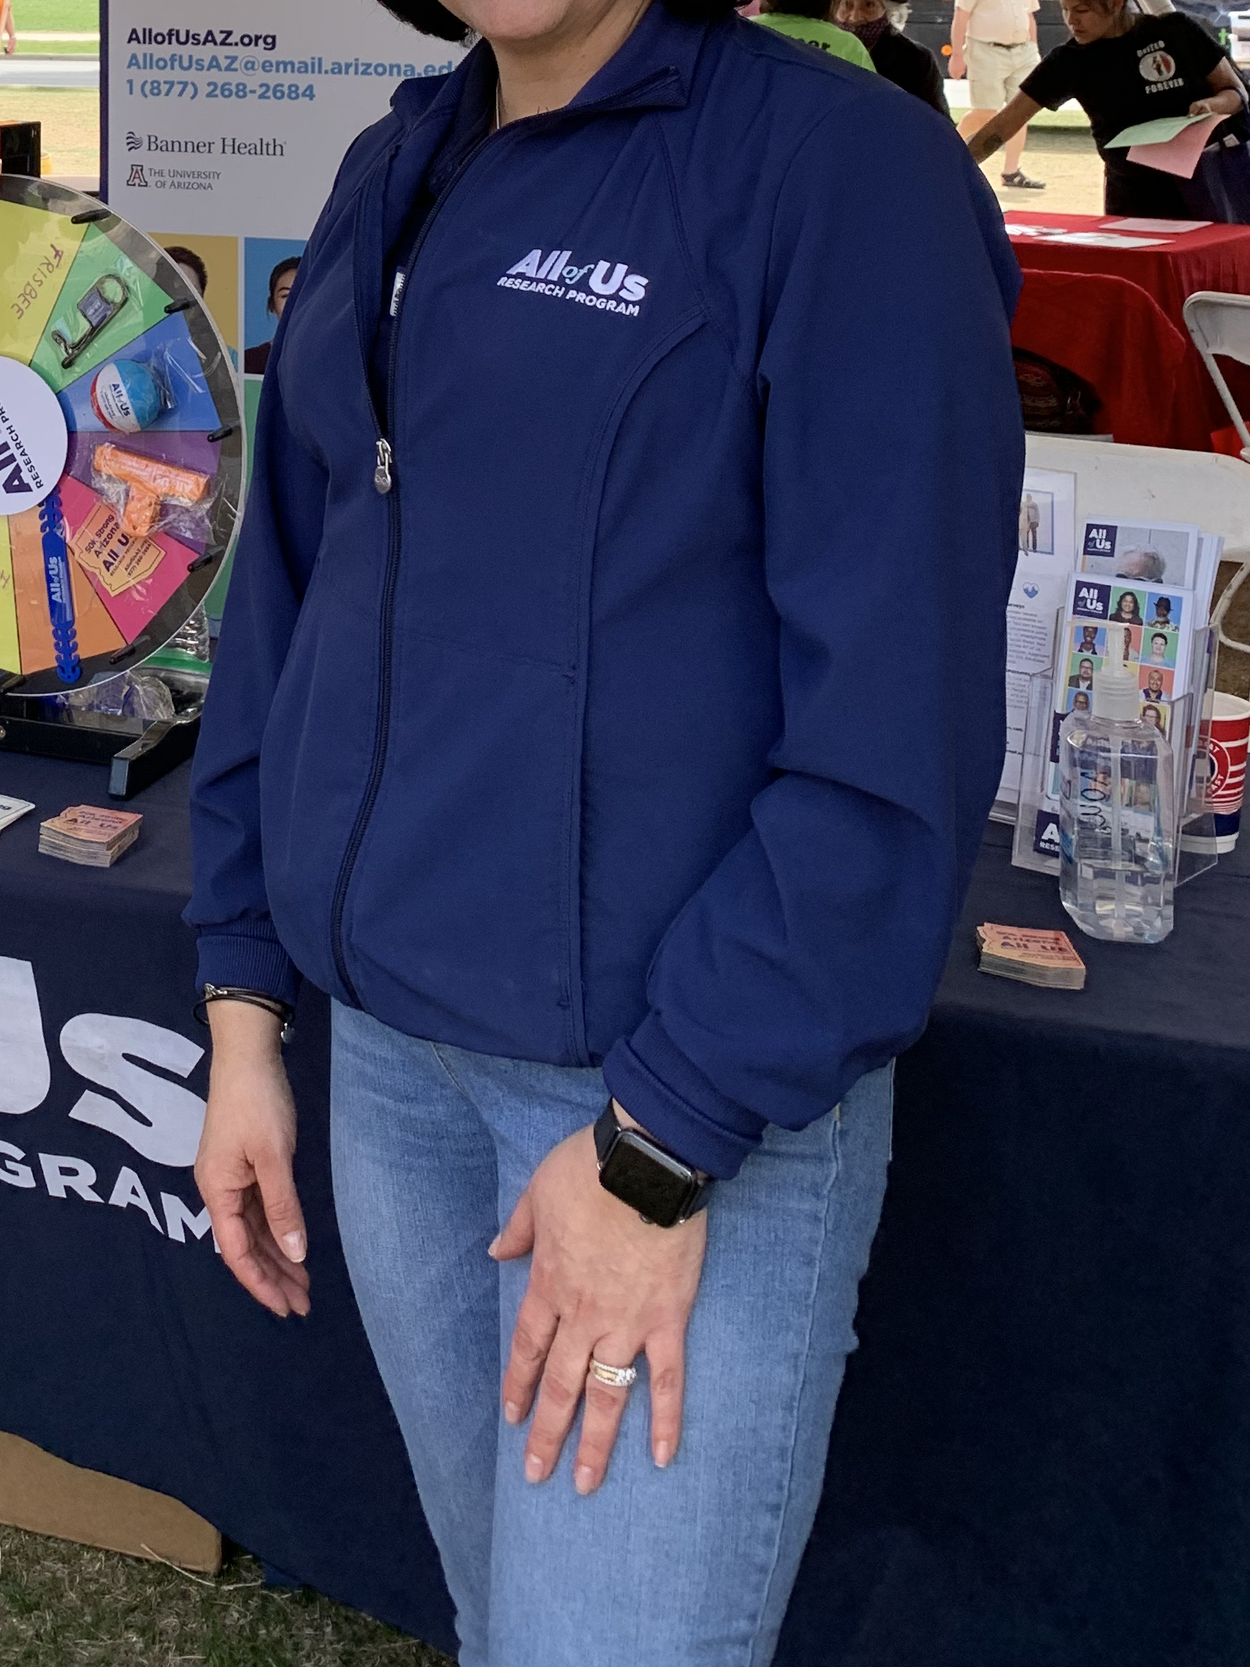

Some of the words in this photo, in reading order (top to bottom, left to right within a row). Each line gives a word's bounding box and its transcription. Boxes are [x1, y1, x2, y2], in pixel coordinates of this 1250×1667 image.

[127, 28, 277, 51] AllofUsAZ.org
[127, 52, 456, 77] AllofUsAZ@email.arizona.ed
[126, 79, 134, 95] 1
[140, 79, 199, 101] (877)
[205, 81, 316, 101] 268-2684
[147, 135, 215, 154] Banner
[220, 137, 285, 156] Health
[148, 168, 165, 178] THE
[168, 169, 221, 180] UNIVERSITY
[155, 180, 166, 189] OF
[169, 181, 213, 191] ARIZONA
[11, 244, 65, 320] FRISBEE
[506, 249, 572, 282] All
[562, 263, 595, 285] of
[588, 260, 649, 302] Us
[497, 276, 566, 297] RESEARCH
[565, 290, 640, 317] PROGRAM
[6, 424, 44, 489] RESEARCH
[94, 513, 115, 539] Strong
[99, 549, 120, 572] All
